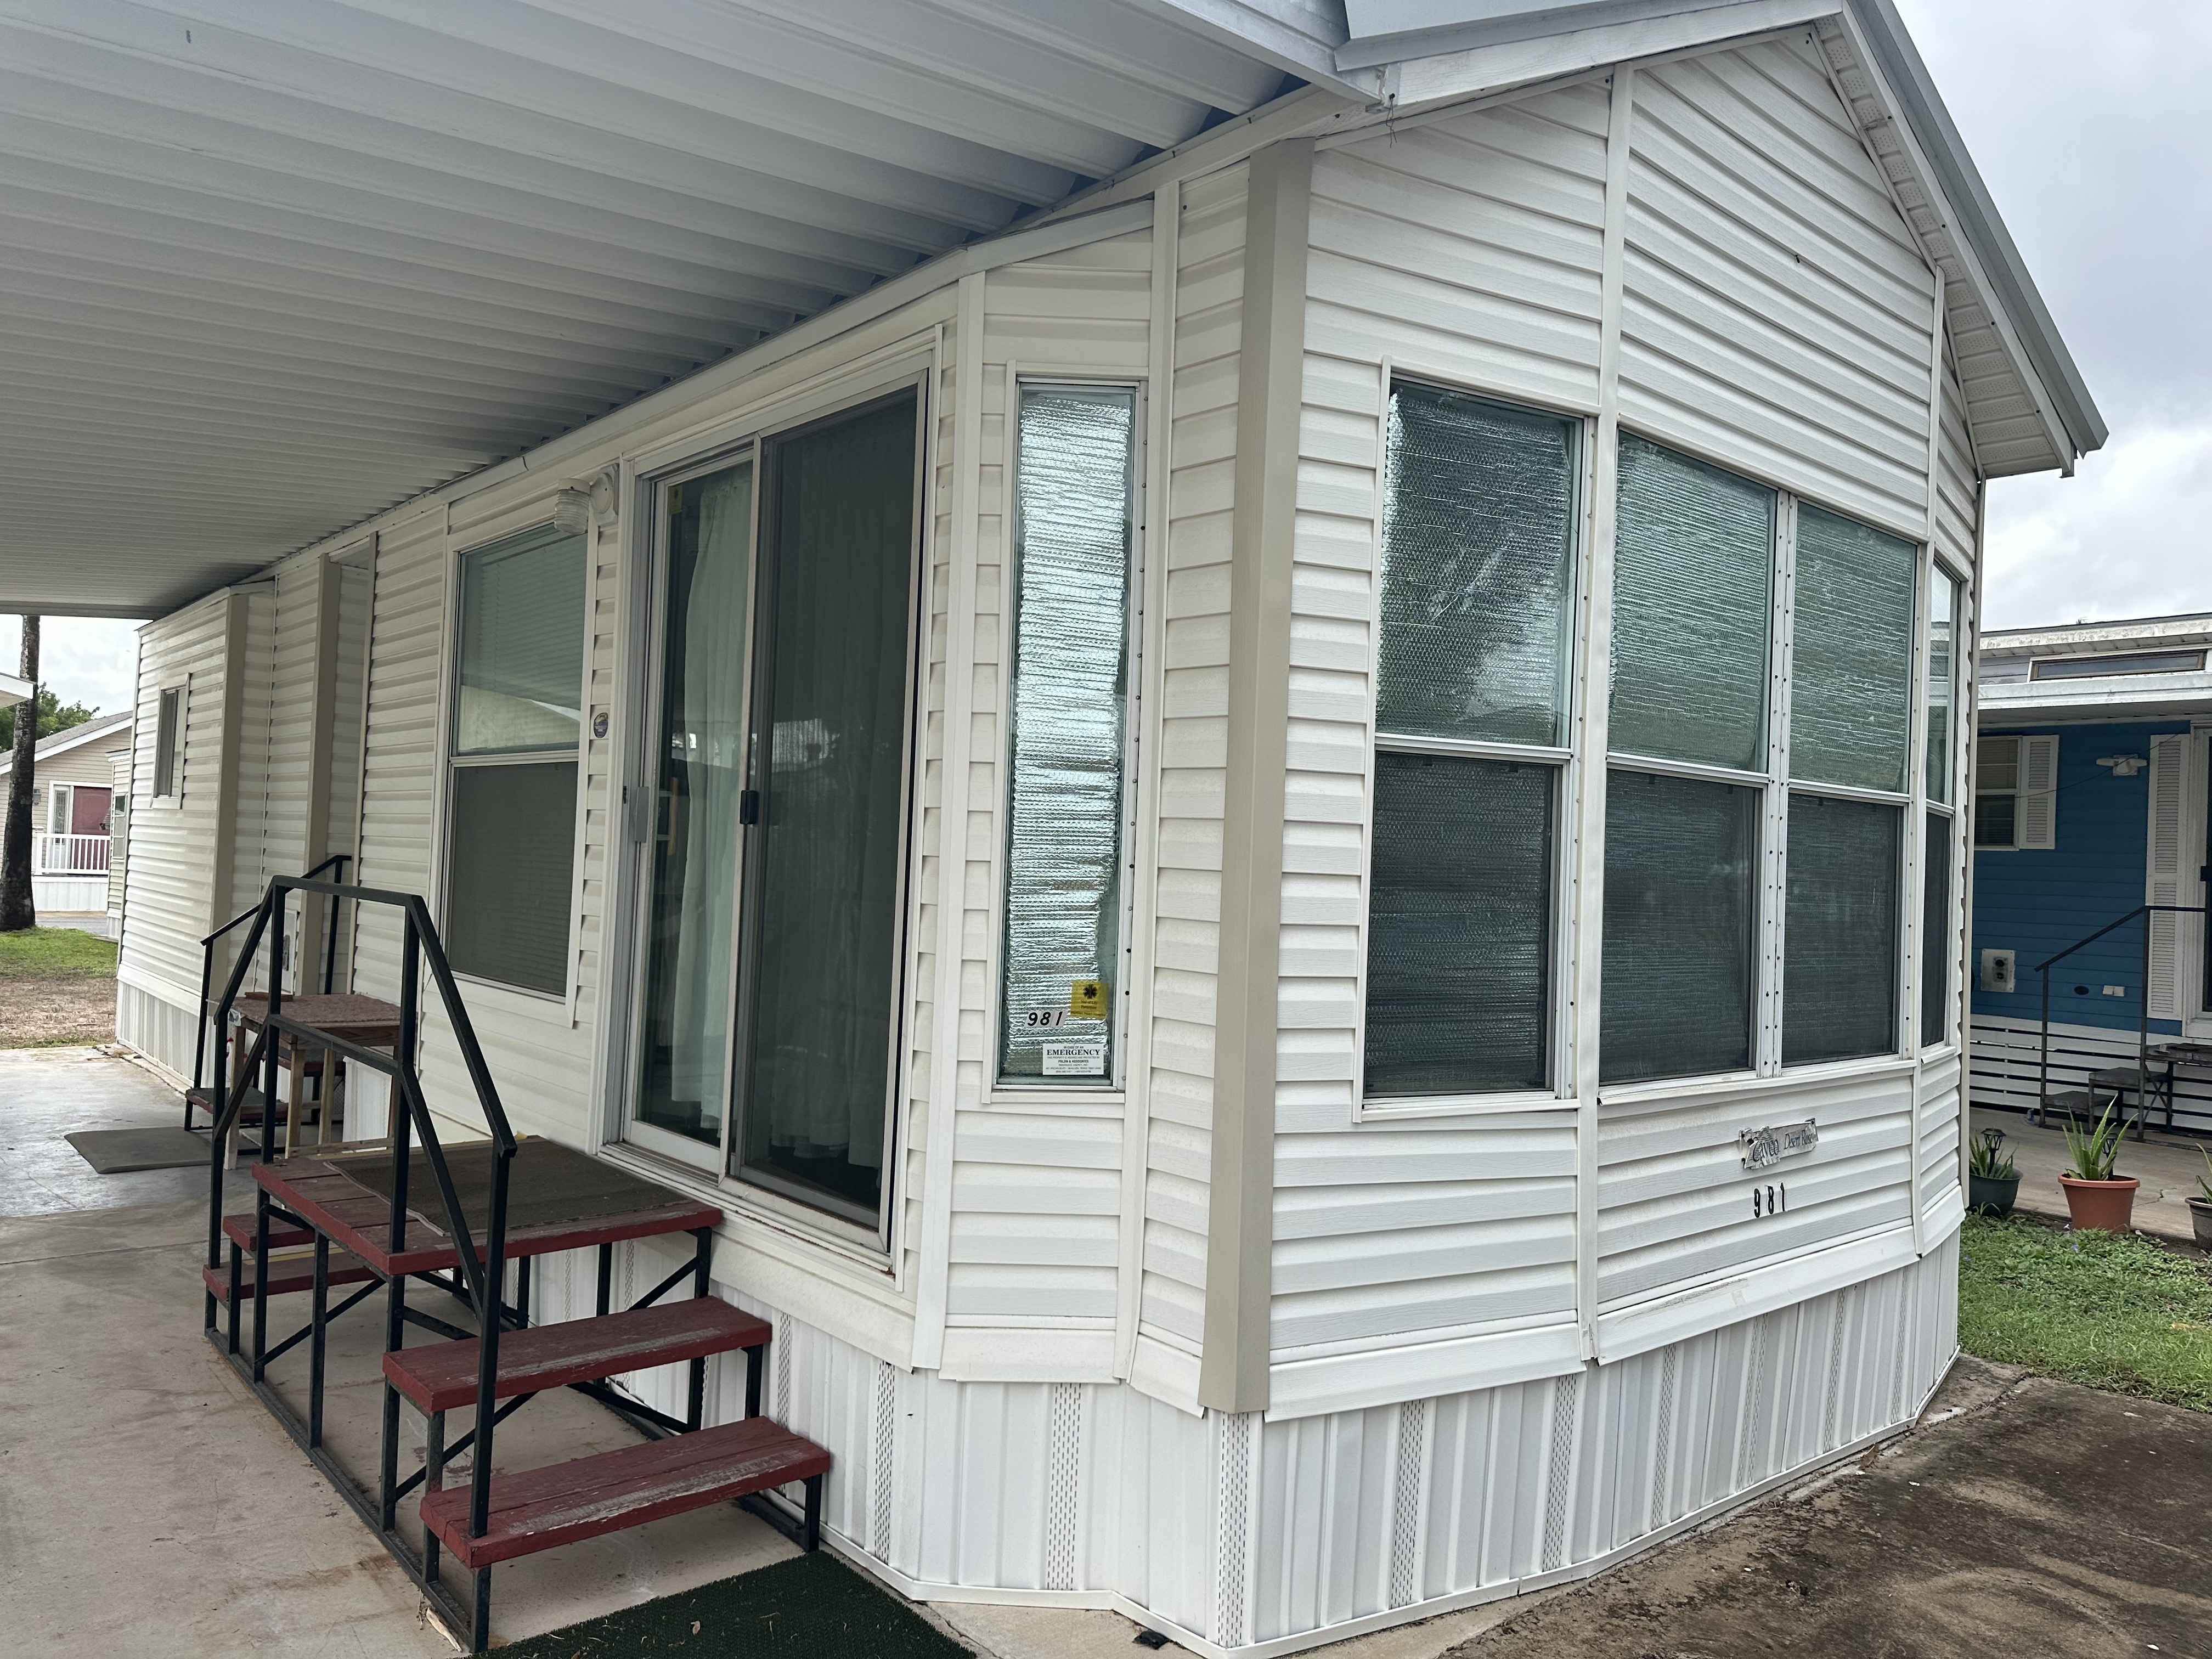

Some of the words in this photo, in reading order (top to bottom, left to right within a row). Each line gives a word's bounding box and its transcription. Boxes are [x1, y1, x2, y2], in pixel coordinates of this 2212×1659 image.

[1027, 1011, 1063, 1026] 981
[1784, 1133, 1801, 1149] Desert
[1802, 1129, 1813, 1146] Rose
[1754, 1182, 1785, 1218] 981
